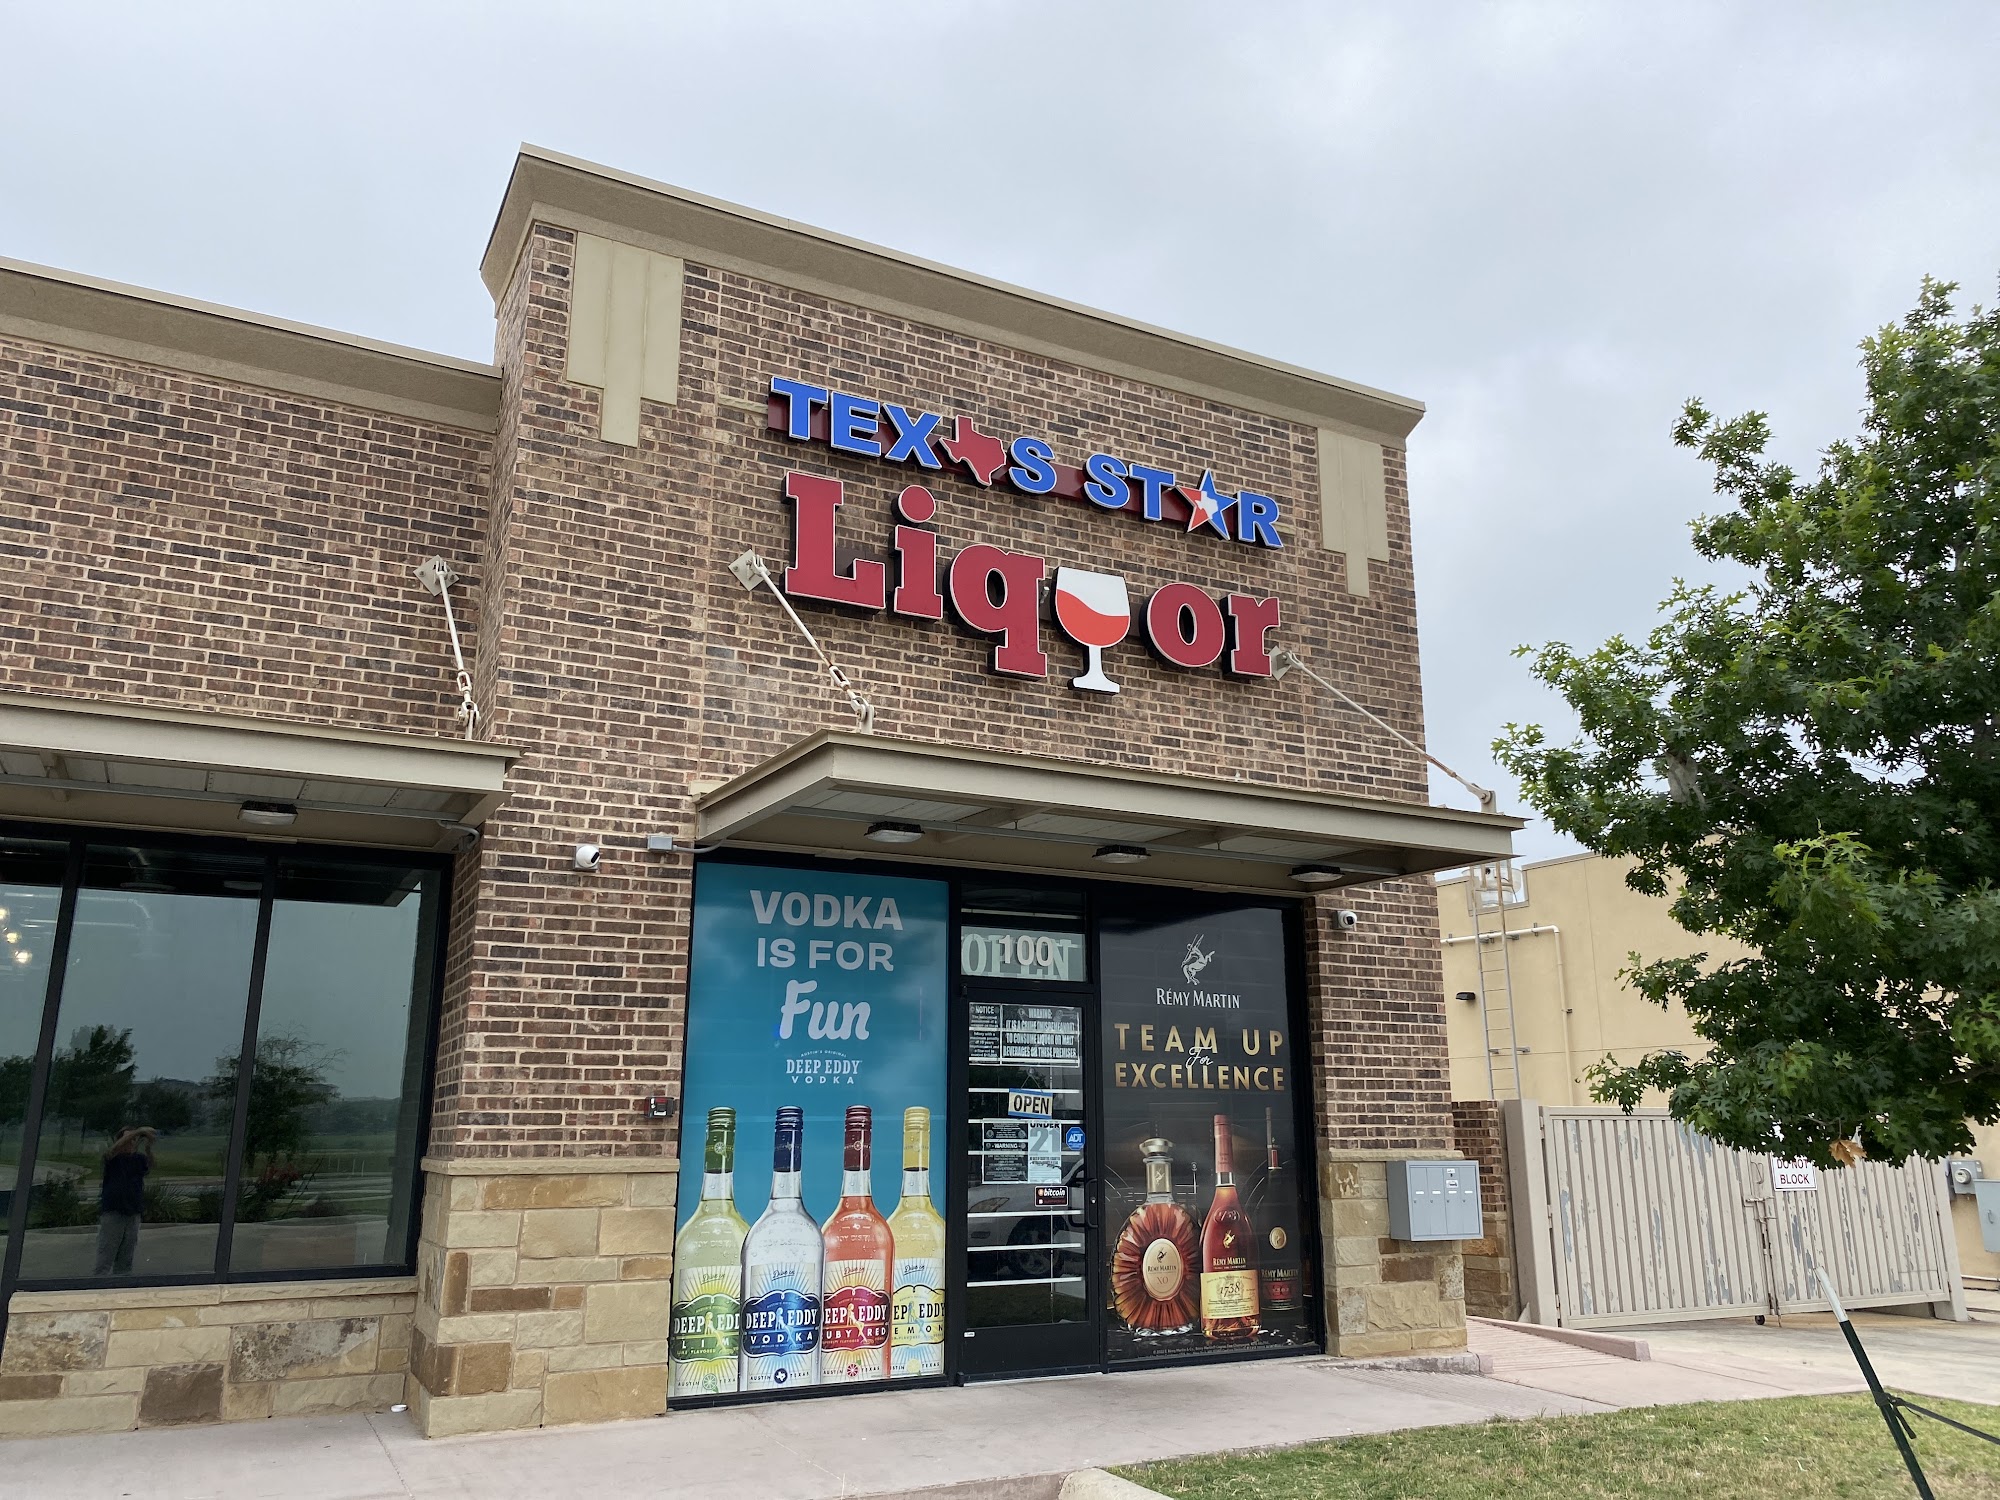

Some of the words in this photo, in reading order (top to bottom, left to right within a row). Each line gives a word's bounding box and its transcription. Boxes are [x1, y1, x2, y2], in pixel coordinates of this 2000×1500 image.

[750, 889, 903, 931] VODKA
[757, 938, 796, 968] IS
[808, 939, 894, 972] FOR
[999, 934, 1054, 967] 100
[1156, 987, 1190, 1007] RÉMY
[1192, 989, 1241, 1009] MARTIN
[779, 979, 871, 1040] Fun
[975, 1005, 995, 1014] NOTICE
[1006, 1032, 1013, 1044] TO
[1013, 1033, 1037, 1044] CONSUME
[1037, 1033, 1055, 1046] LIQUOR
[1114, 1023, 1218, 1054] TEAM
[1242, 1028, 1283, 1056] UP
[1038, 1046, 1053, 1057] THESE
[1185, 1045, 1214, 1068] For
[786, 1059, 821, 1074] DEEP
[824, 1059, 860, 1075] EDDY
[791, 1075, 854, 1085] VODKA
[1115, 1062, 1285, 1091] EXCELLENCE
[1013, 1094, 1050, 1115] OPEN
[1030, 1128, 1060, 1153] 21
[1067, 1133, 1083, 1143] ADT
[1791, 1159, 1809, 1169] NOT
[1780, 1173, 1810, 1185] BLOCK
[1043, 1188, 1066, 1197] bitcoin
[1227, 1256, 1246, 1265] MARTIN
[1156, 1276, 1169, 1285] XO
[1220, 1281, 1241, 1298] 1738
[746, 1311, 776, 1329] DEEP
[787, 1308, 818, 1326] EDDY
[858, 1304, 887, 1322] EDDY
[673, 1315, 705, 1334] DEEP
[822, 1329, 852, 1339] UBY
[867, 1327, 886, 1337] RED
[750, 1331, 813, 1345] VODKA
